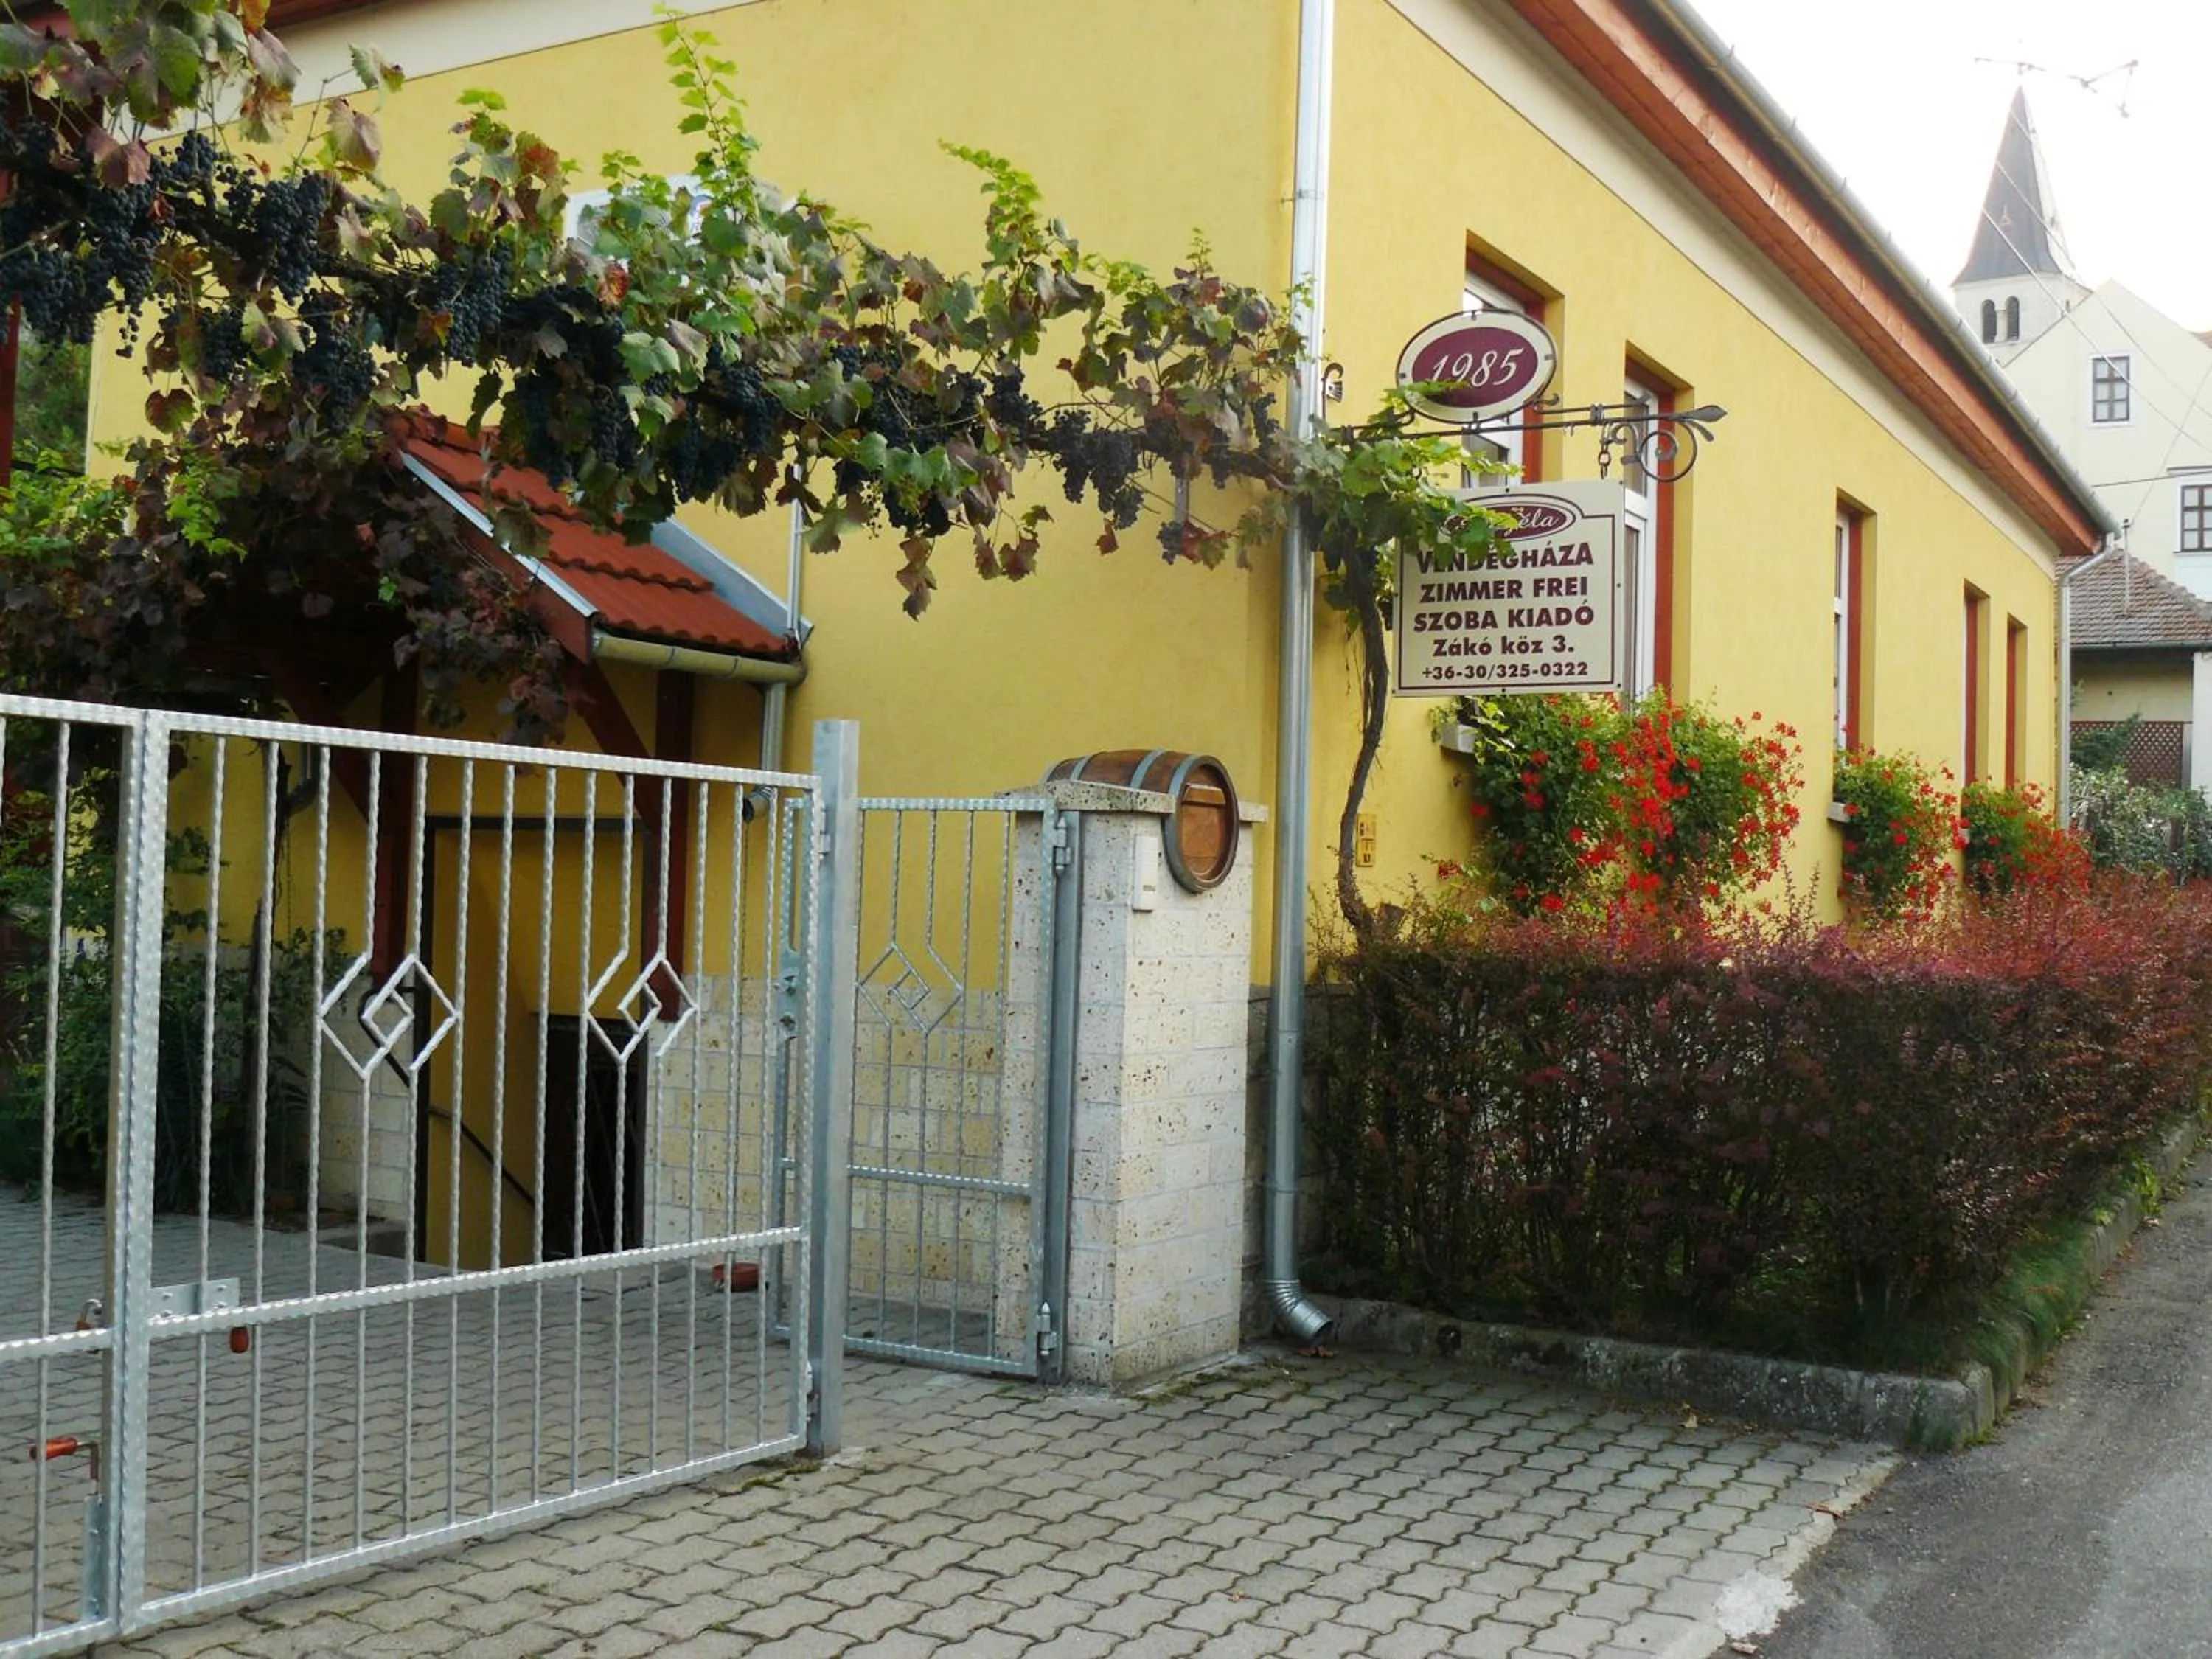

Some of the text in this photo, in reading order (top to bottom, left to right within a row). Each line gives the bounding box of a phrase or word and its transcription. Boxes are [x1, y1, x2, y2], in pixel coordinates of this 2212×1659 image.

[1433, 347, 1524, 387] 1985
[1419, 577, 1588, 603] ZIMMER FREI
[1413, 599, 1594, 632] SZOBA KIADÓ
[1433, 634, 1575, 656] Zákó köz 3.
[1422, 661, 1588, 680] +36-30/325-0322
